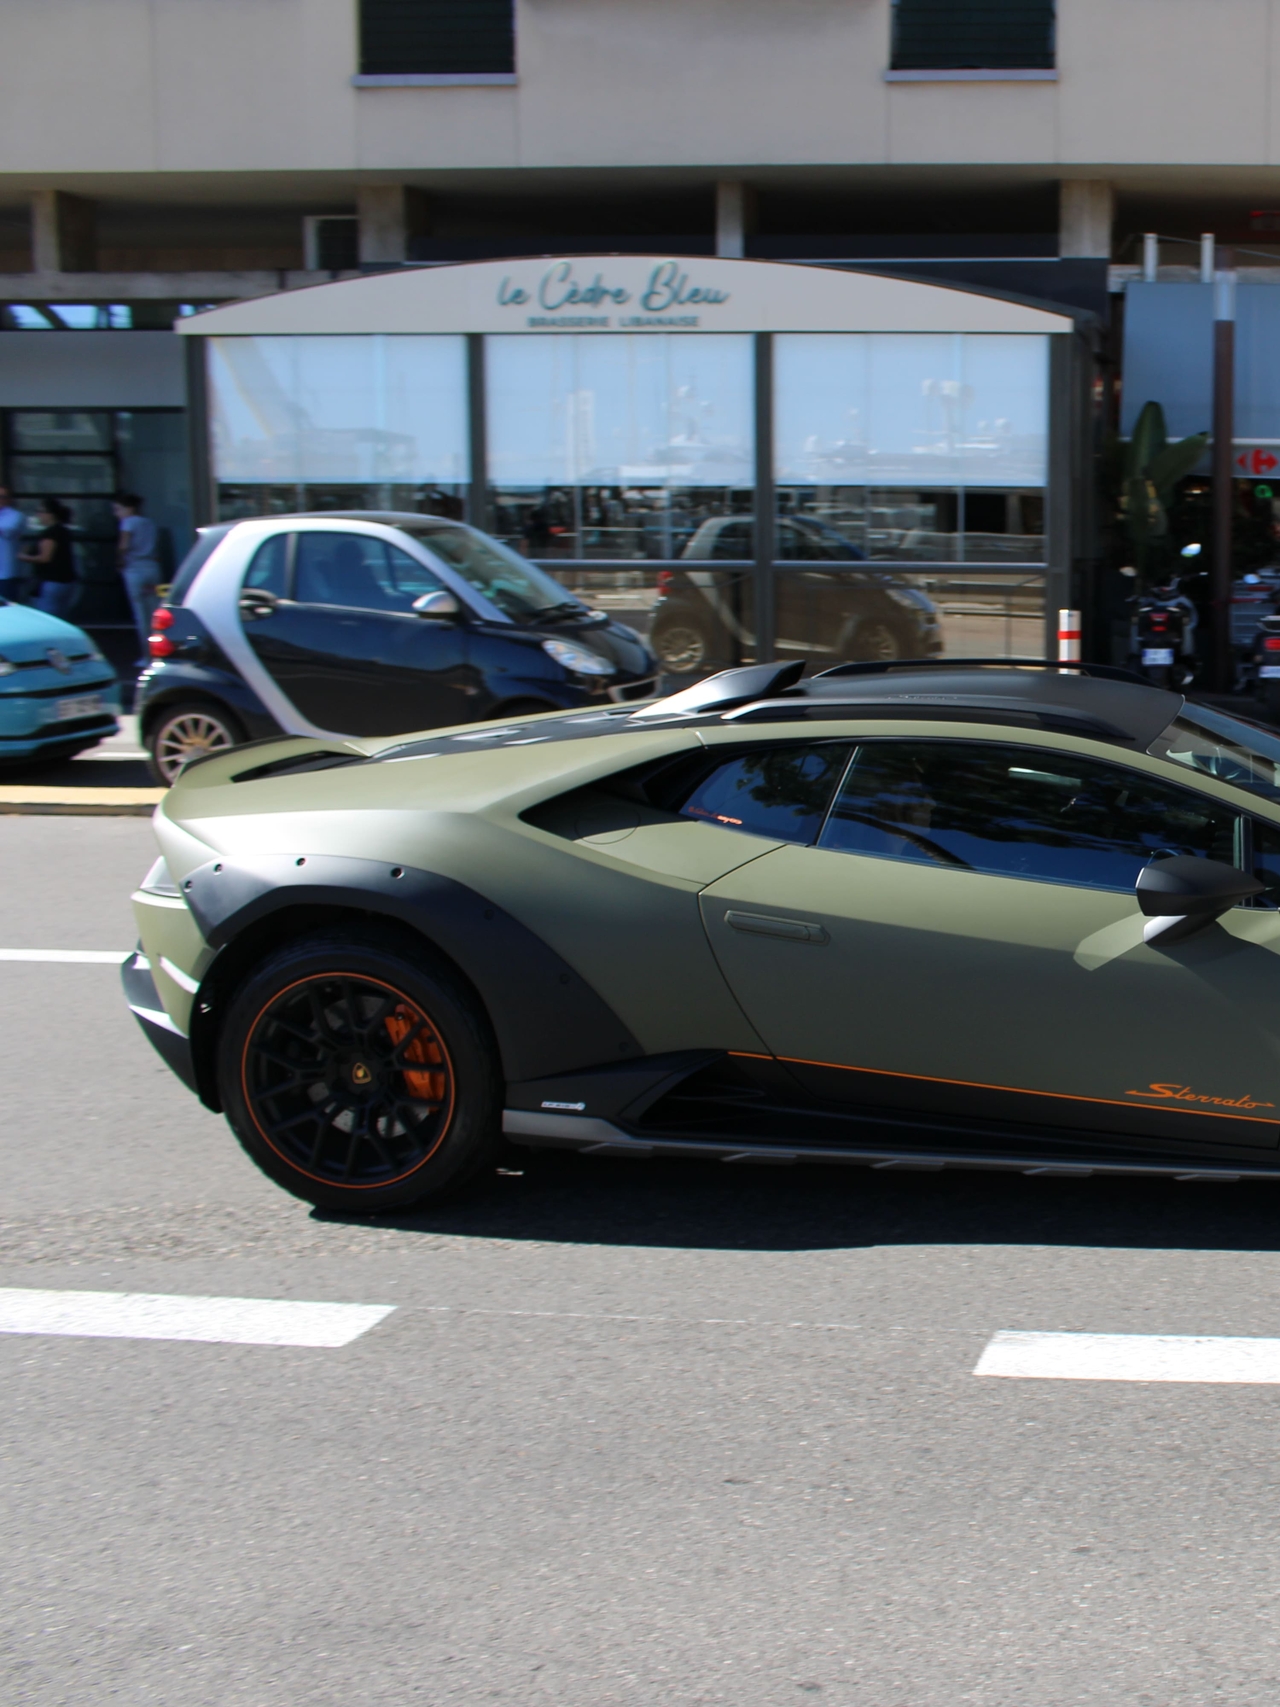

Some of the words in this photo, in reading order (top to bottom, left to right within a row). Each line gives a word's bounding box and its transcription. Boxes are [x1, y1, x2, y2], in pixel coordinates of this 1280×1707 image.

[538, 260, 630, 310] Cèdre
[640, 260, 730, 311] Bleu
[527, 316, 609, 328] BRASSERIE
[619, 316, 699, 328] LIBANAISE
[1125, 1083, 1276, 1109] Sterrato
